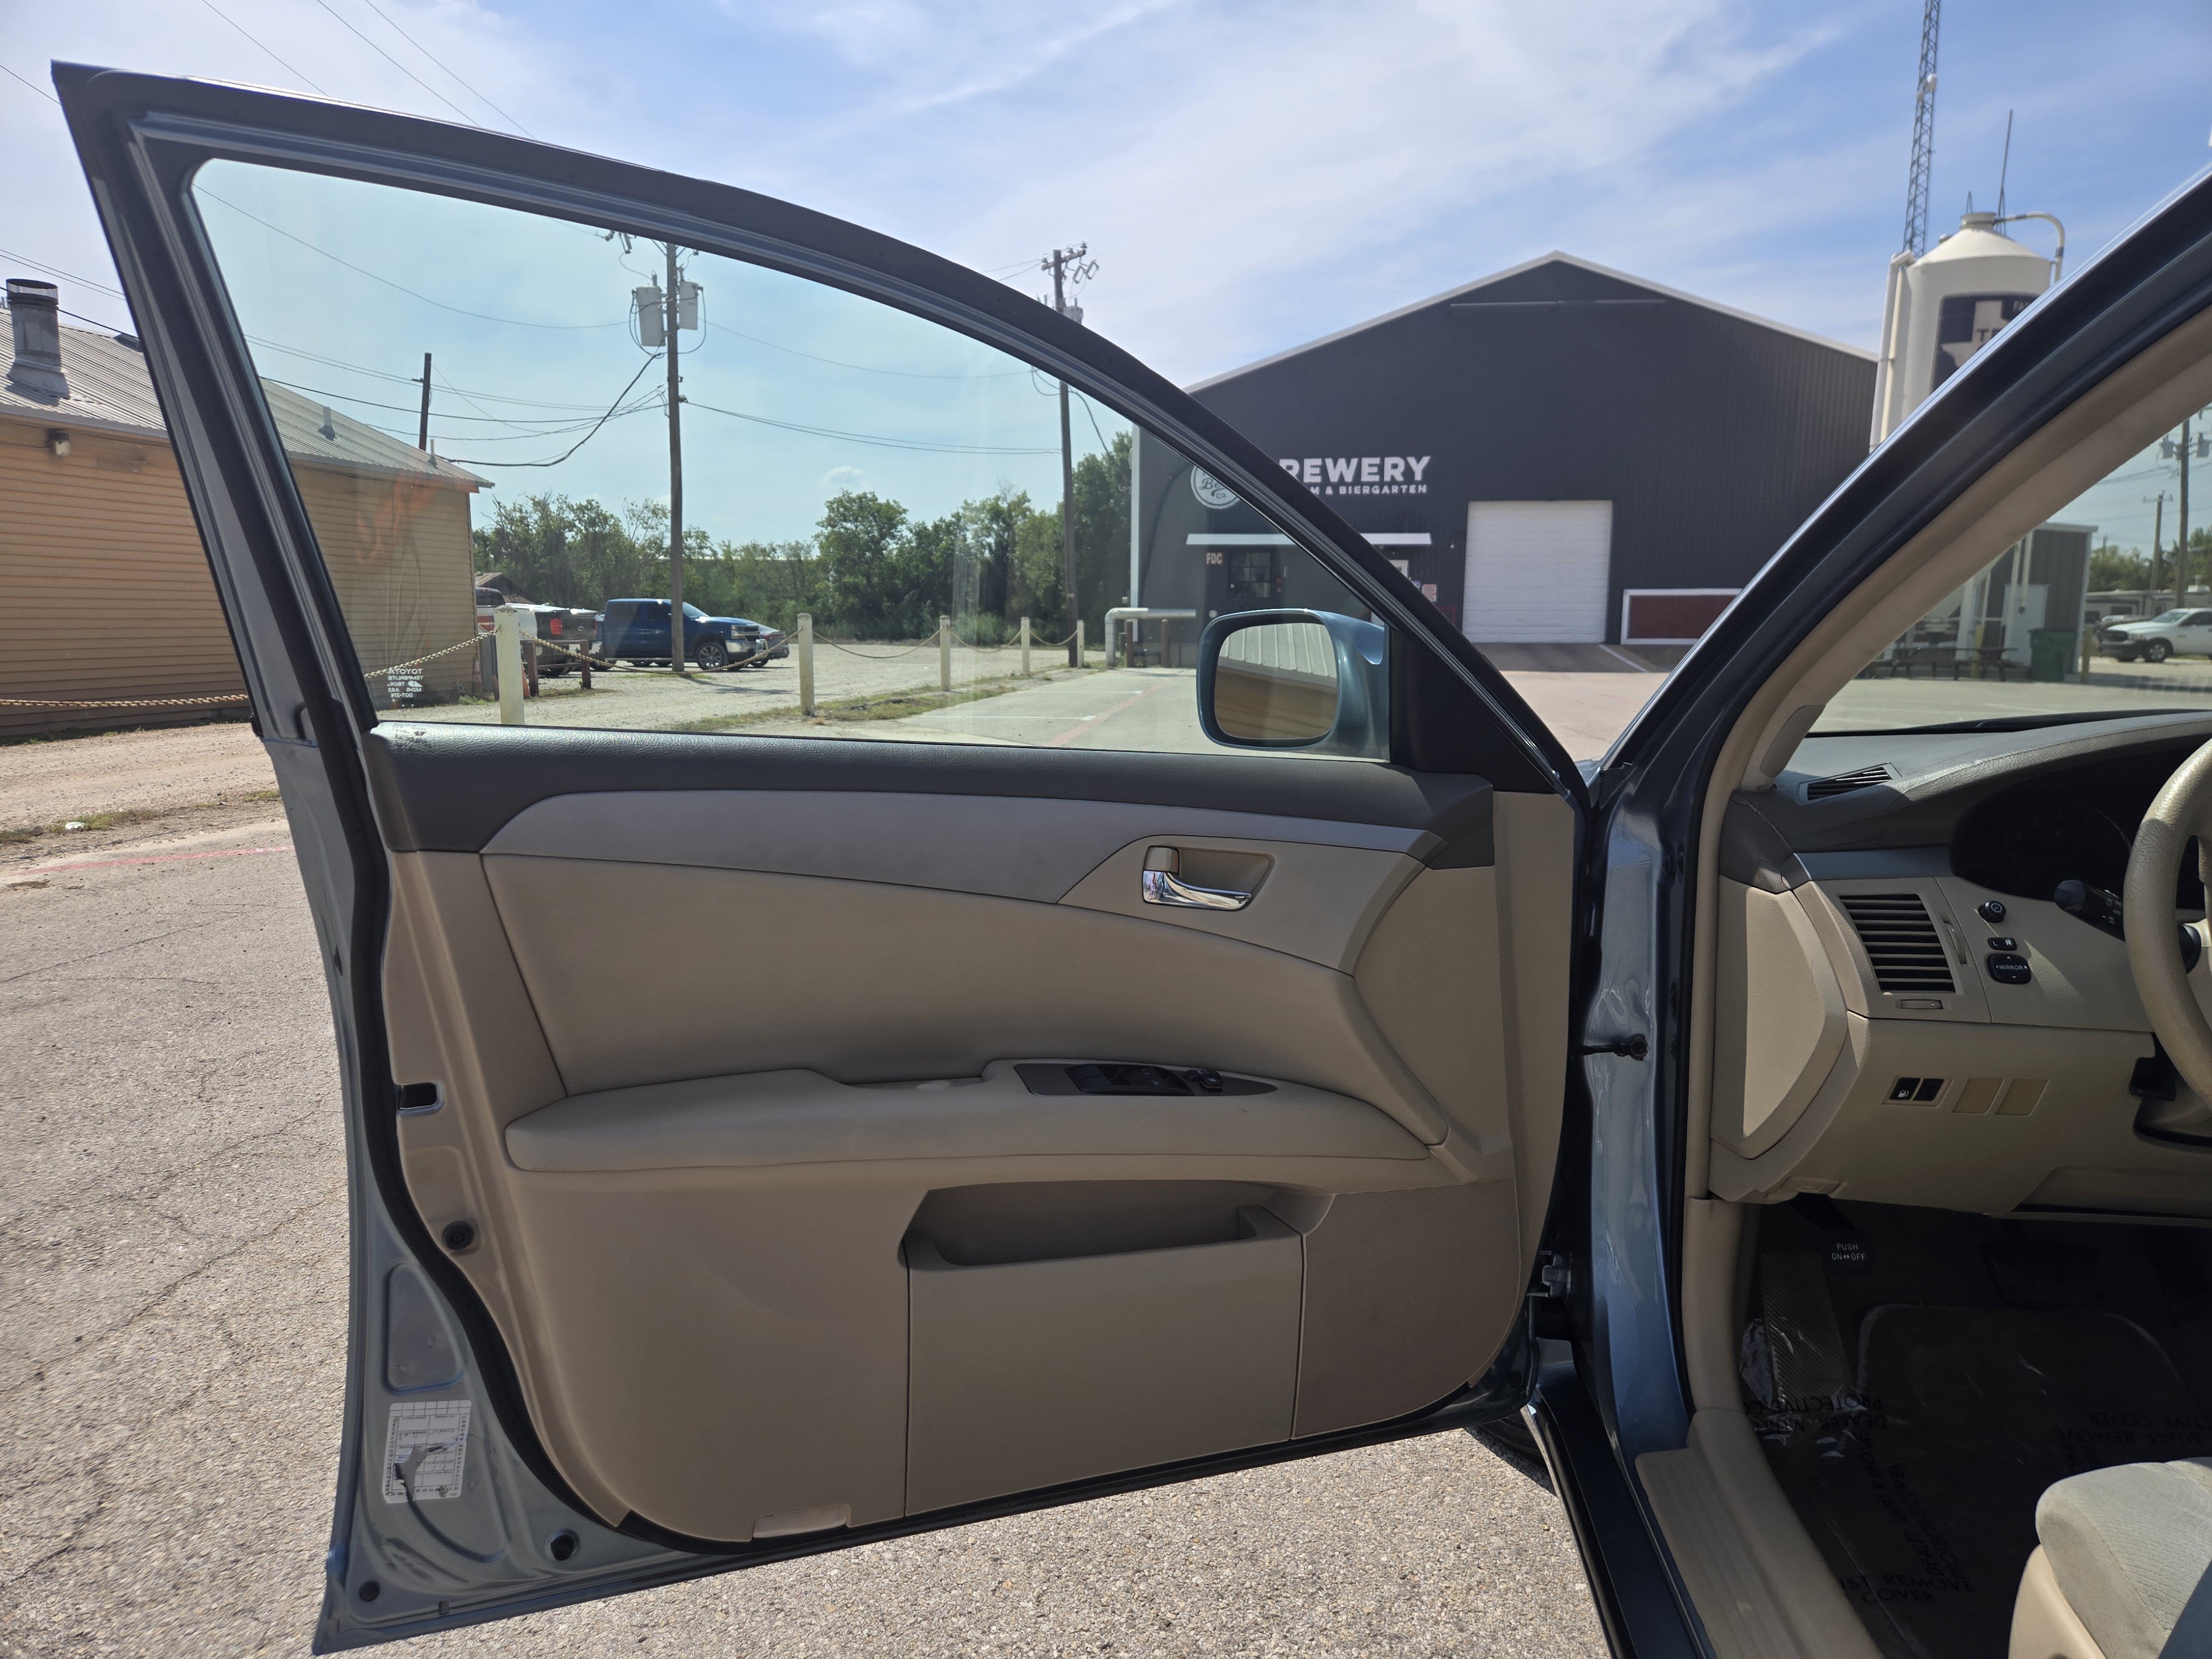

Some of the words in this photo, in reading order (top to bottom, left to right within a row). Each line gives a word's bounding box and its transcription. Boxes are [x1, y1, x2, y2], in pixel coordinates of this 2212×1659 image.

[1325, 486, 1333, 494] &
[1339, 484, 1427, 494] BIERGARTEN
[1206, 552, 1223, 565] FDC
[1819, 1413, 1888, 1431] DEALER
[1882, 1573, 1976, 1593] REMOVE
[1863, 1588, 1935, 1603] COVER
